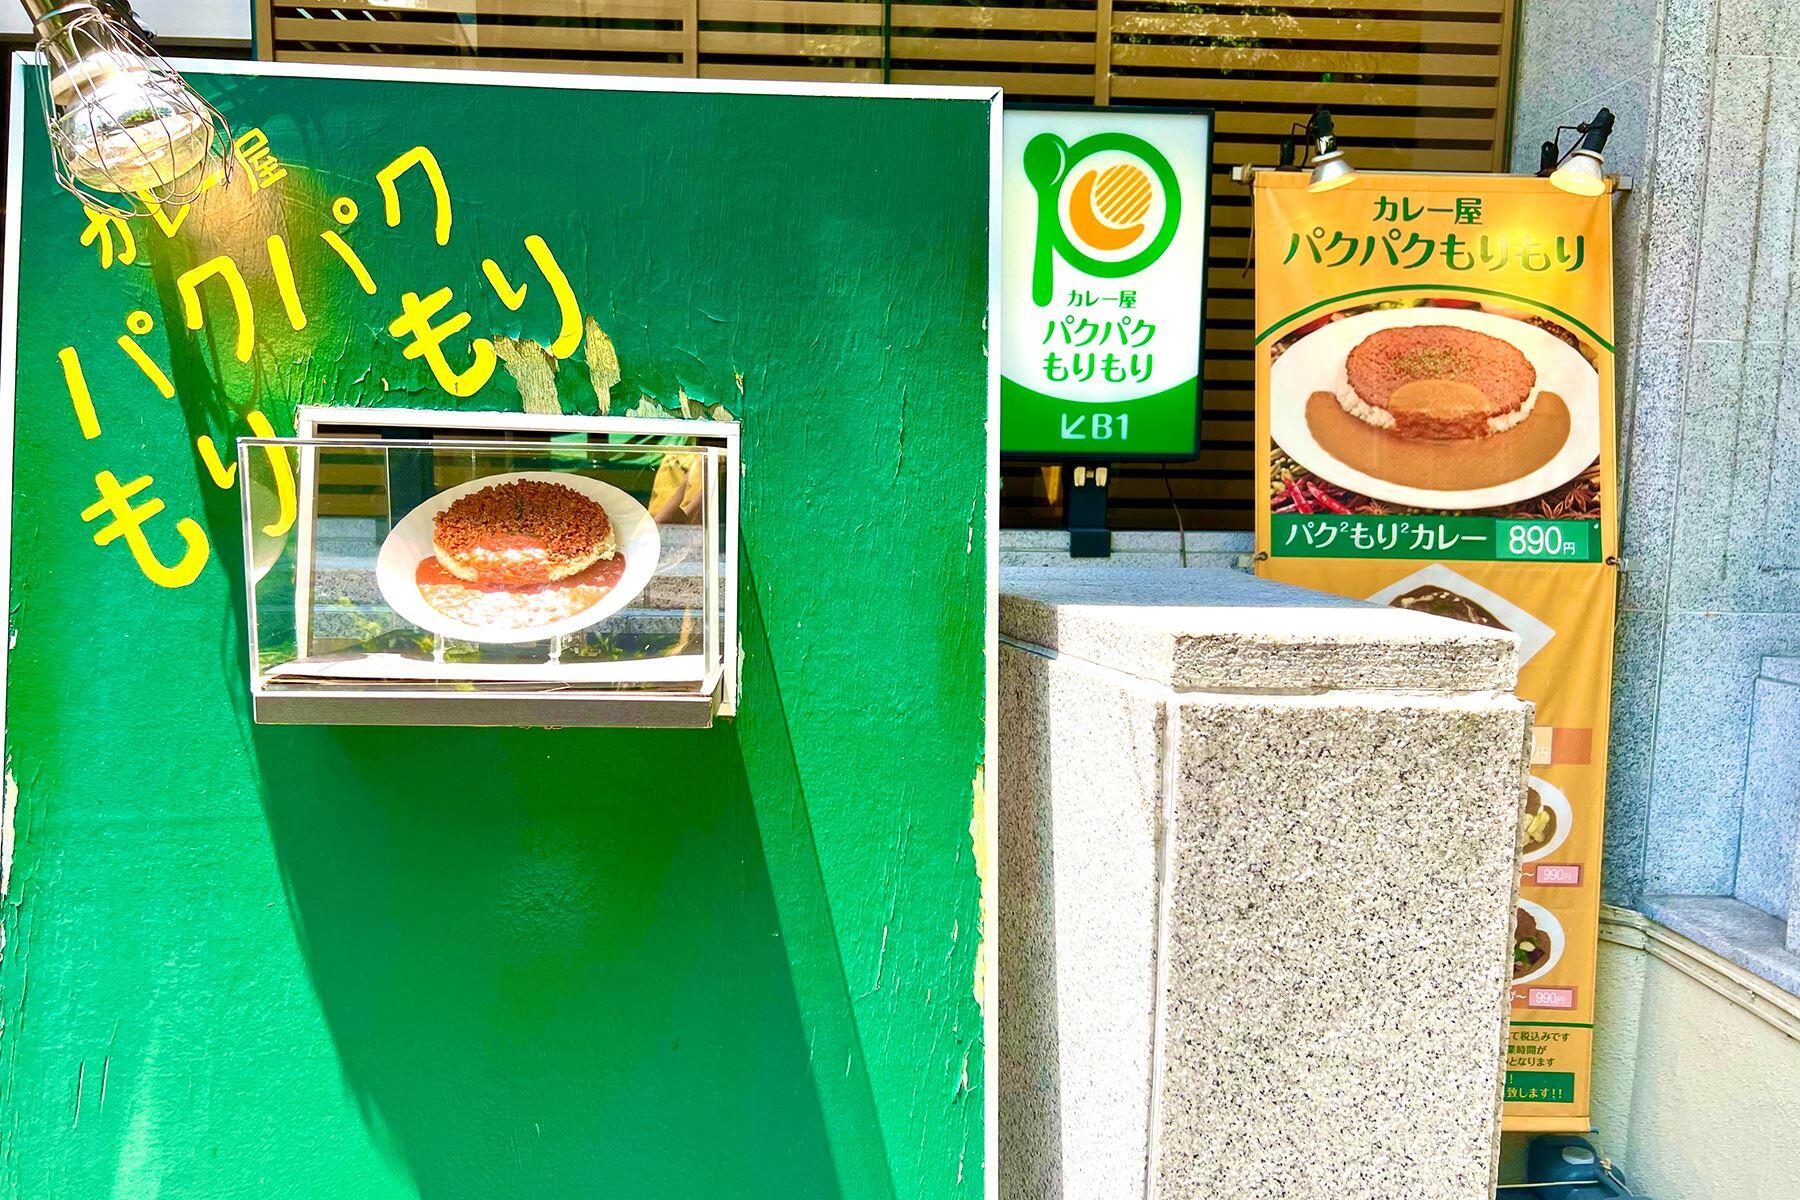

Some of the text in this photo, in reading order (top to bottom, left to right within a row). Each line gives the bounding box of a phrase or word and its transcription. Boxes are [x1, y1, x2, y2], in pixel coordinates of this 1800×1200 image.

[1372, 195, 1483, 225] カレー屋
[1283, 226, 1585, 272] パクパクもりもり
[58, 145, 452, 440] パクパク
[1066, 289, 1137, 309] カレー屋
[1042, 315, 1156, 348] パクパク
[1042, 352, 1153, 382] もりもり
[1091, 413, 1129, 440] B1
[1508, 525, 1576, 556] 890円
